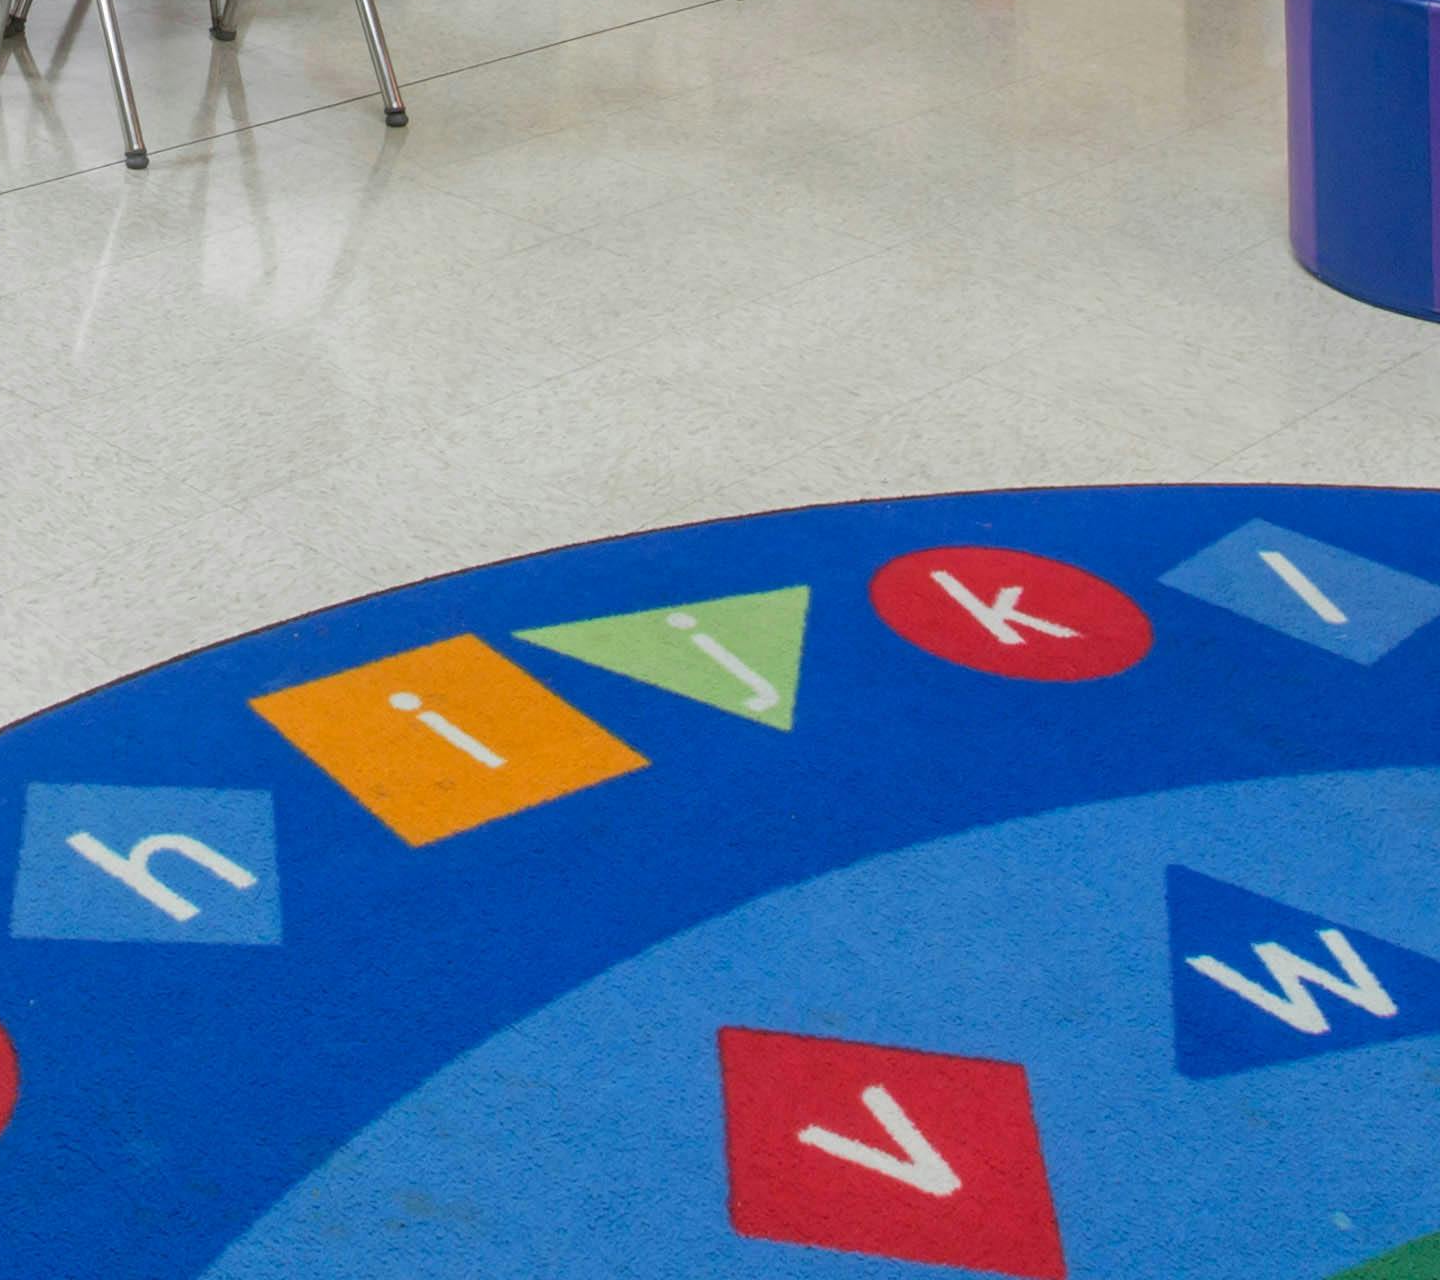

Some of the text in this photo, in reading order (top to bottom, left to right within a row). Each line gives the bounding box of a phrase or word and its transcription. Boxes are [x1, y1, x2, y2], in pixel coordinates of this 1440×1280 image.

[931, 570, 1073, 646] k
[665, 611, 781, 713] j
[390, 692, 507, 768] i
[66, 830, 256, 921] h
[1188, 928, 1397, 1034] w
[798, 1085, 962, 1197] v
